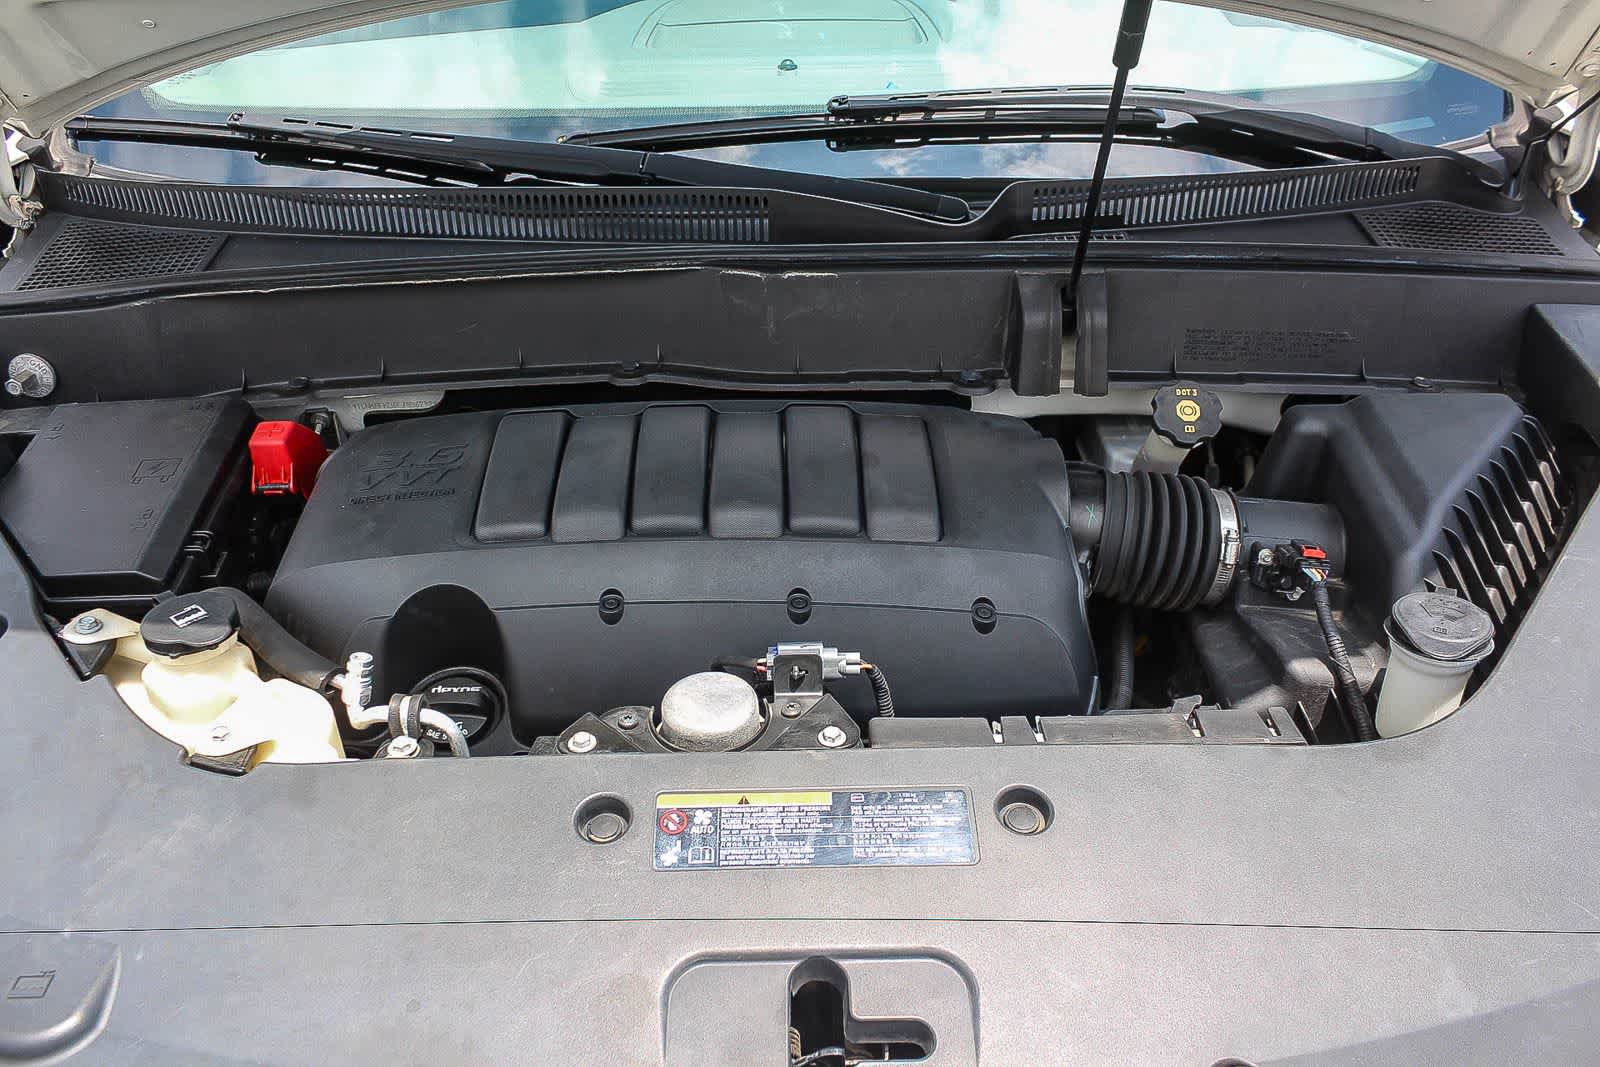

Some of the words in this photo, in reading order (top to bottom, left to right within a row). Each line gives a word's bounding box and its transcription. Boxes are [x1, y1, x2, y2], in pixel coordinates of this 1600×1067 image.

[1175, 388, 1191, 397] DOT
[1192, 388, 1198, 397] 3
[426, 729, 441, 740] SAE
[690, 826, 714, 834] AUTO
